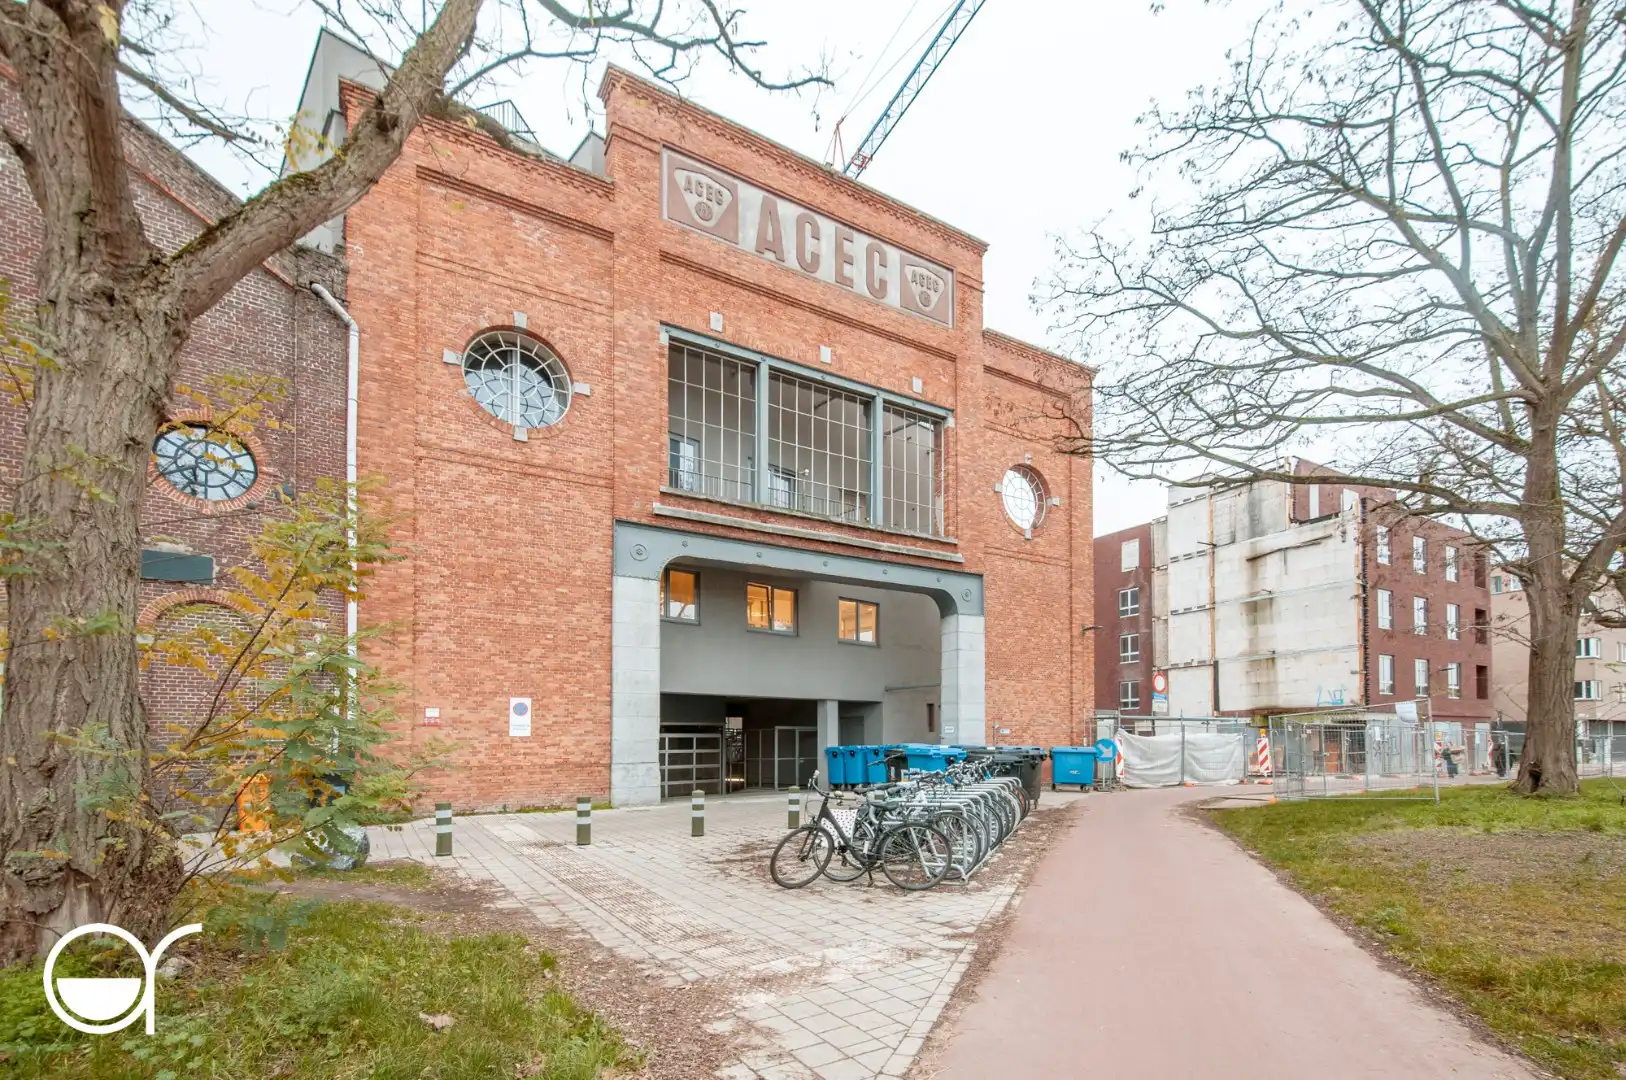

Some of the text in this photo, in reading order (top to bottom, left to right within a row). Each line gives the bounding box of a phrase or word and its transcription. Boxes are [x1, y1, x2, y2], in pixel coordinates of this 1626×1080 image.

[683, 175, 724, 206] ACEC
[755, 195, 888, 300] ACEC
[910, 269, 939, 293] ACEC
